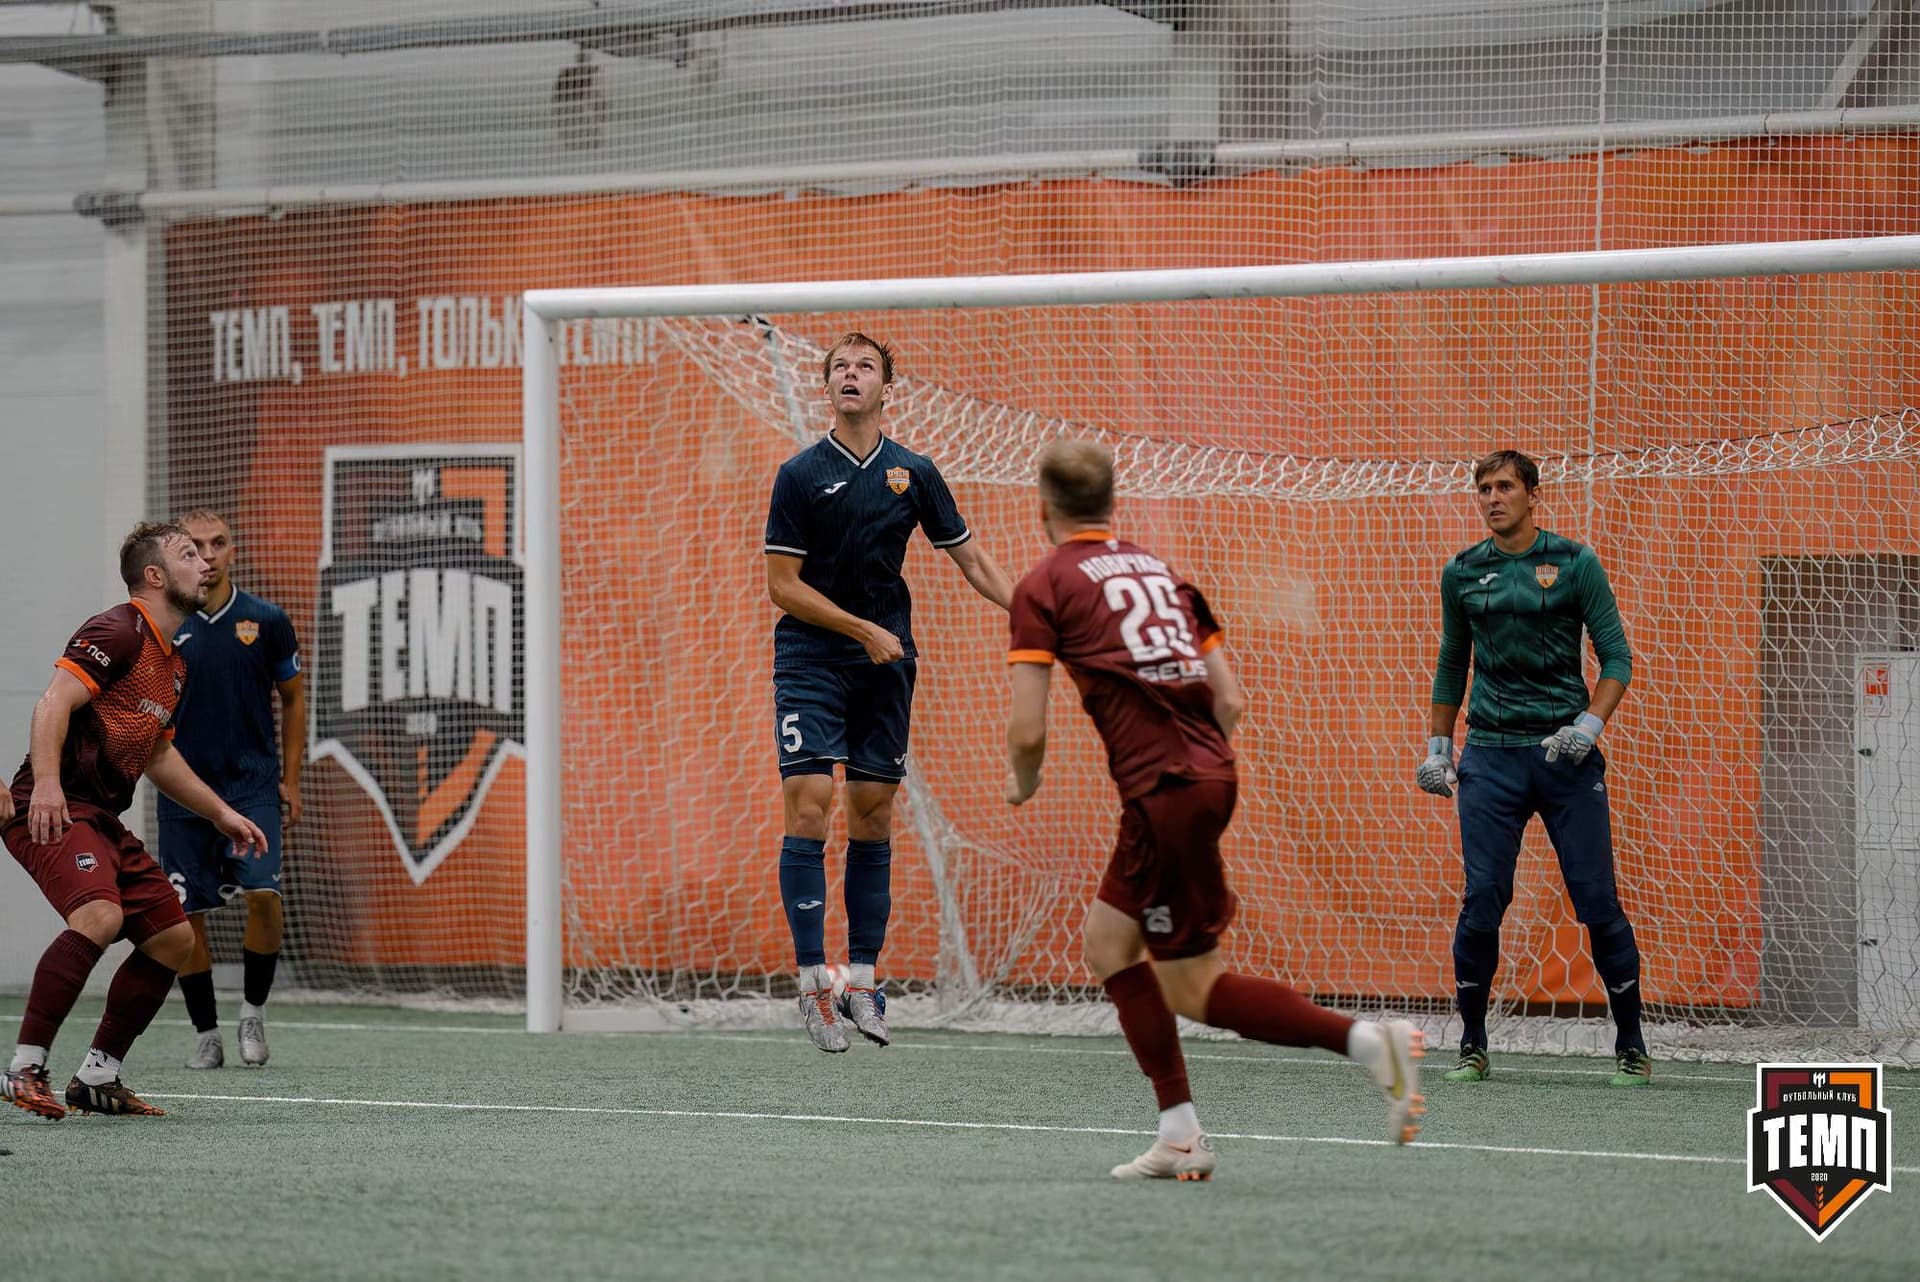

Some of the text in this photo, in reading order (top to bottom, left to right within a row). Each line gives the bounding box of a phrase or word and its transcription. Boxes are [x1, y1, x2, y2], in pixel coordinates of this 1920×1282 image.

[209, 310, 302, 385] ТЕМП,
[310, 298, 408, 378] ТЕМП,
[416, 297, 524, 370] ТОЛЬК
[86, 645, 112, 668] ПСБ
[331, 567, 513, 714] ТЕМП
[1103, 575, 1198, 663] 25
[781, 712, 803, 753] 5
